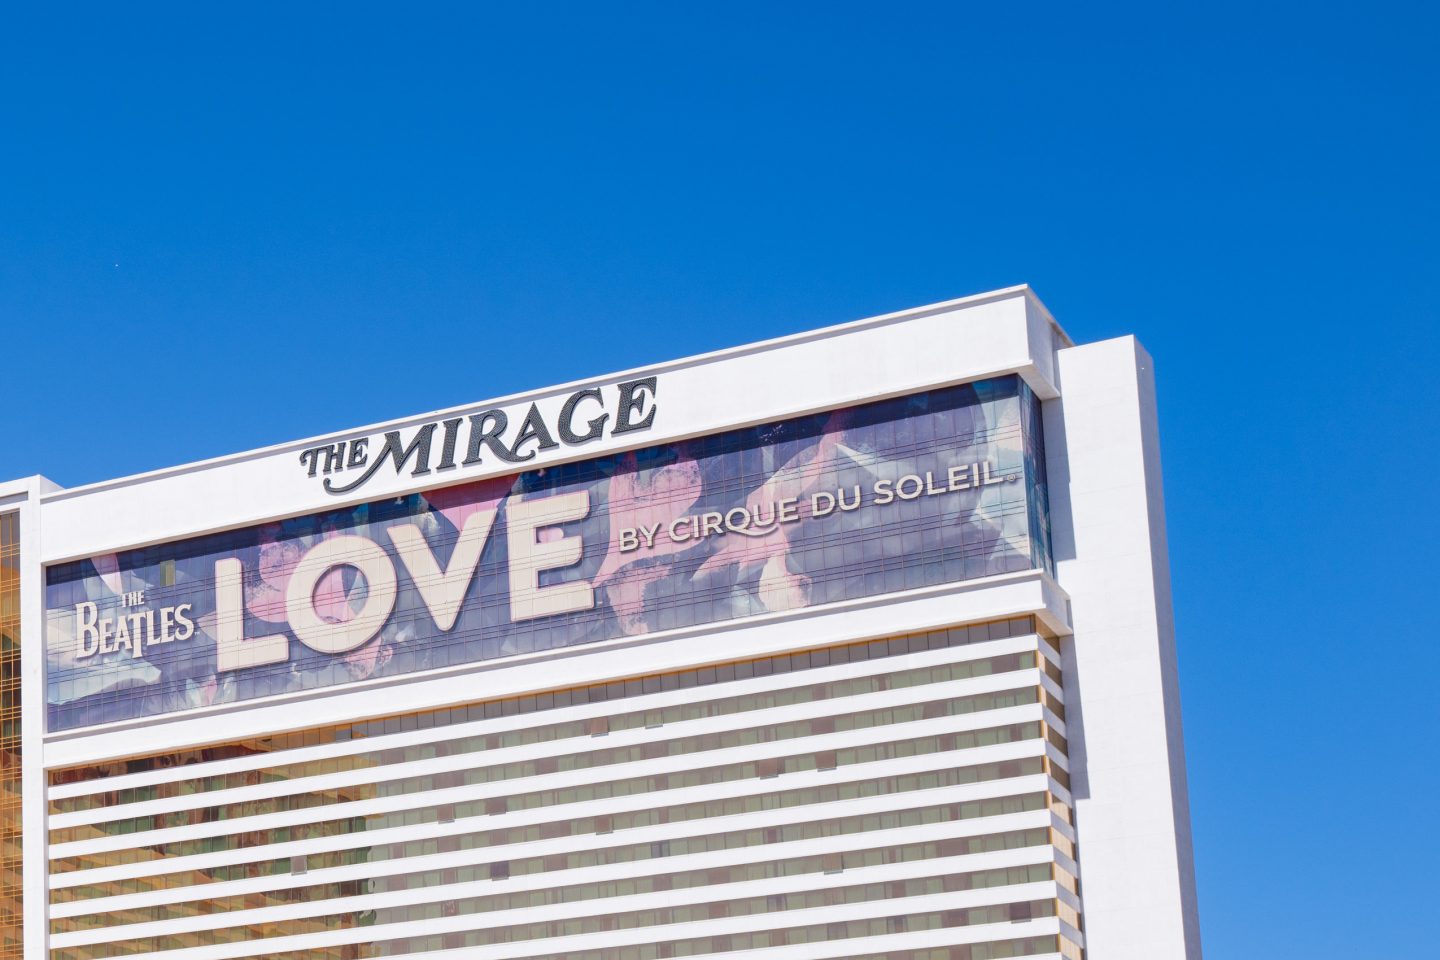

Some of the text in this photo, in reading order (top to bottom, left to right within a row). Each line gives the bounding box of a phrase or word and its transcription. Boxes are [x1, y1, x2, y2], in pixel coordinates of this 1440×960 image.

[299, 376, 658, 493] THE MIRAGE
[618, 460, 1006, 554] BY CIRQUE DU SOLEIL
[119, 589, 146, 608] THE
[213, 490, 595, 673] LOVE
